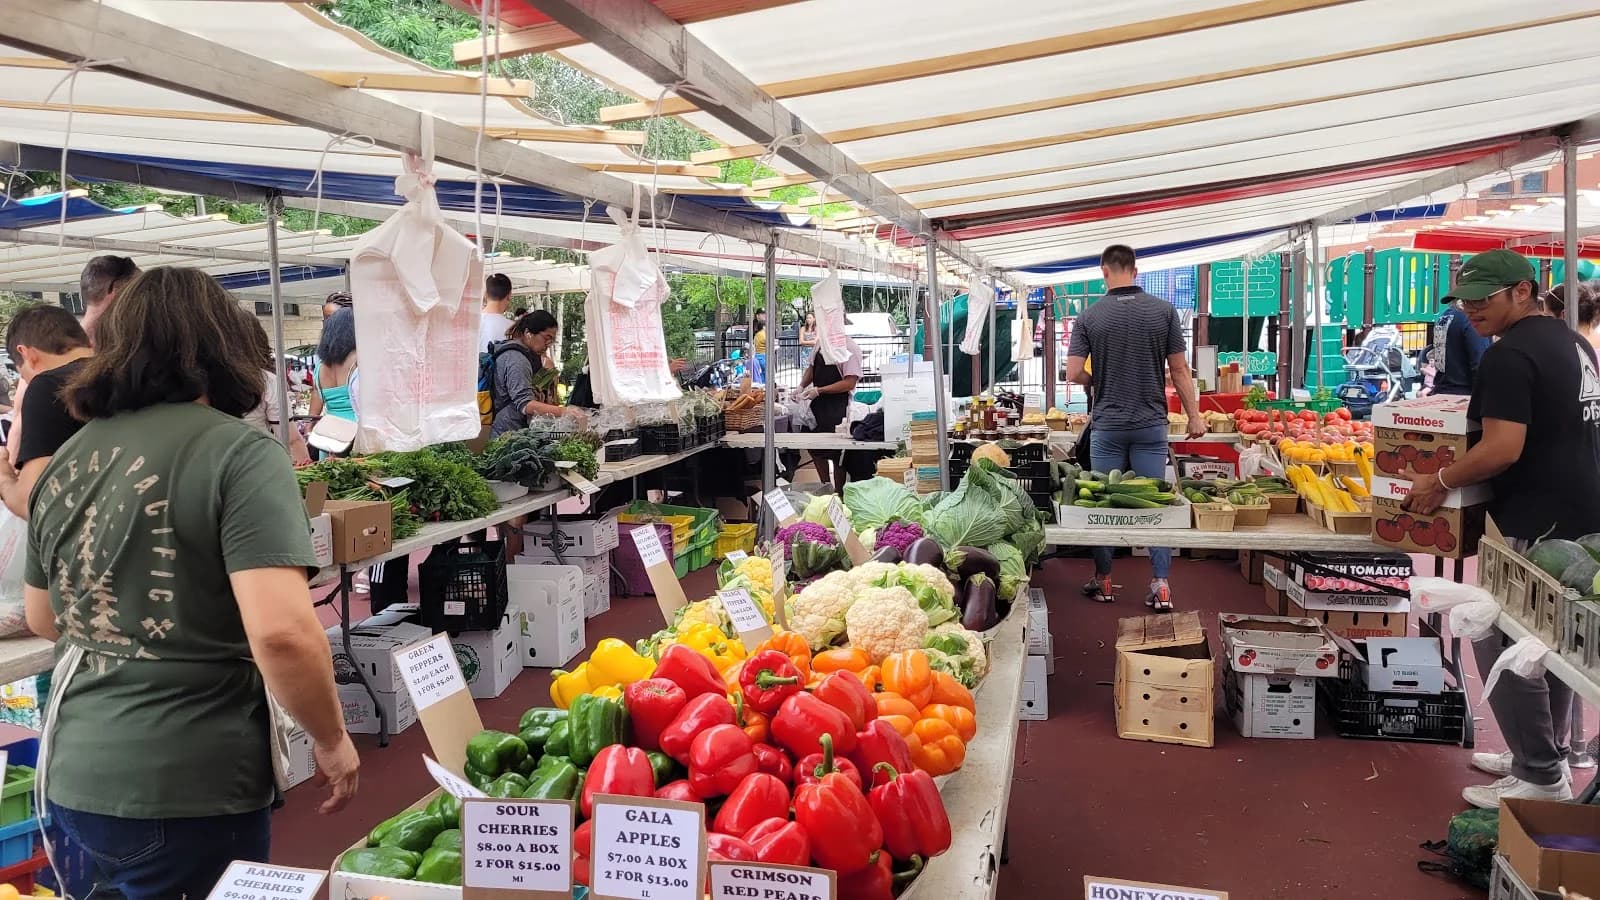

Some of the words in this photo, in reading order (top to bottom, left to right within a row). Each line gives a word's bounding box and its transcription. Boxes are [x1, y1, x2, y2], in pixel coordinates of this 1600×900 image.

[1392, 412, 1444, 428] Tomatoes
[1087, 513, 1134, 526] TOMATOES
[125, 456, 177, 602] PACIFIC
[1350, 565, 1410, 576] TOMATOES
[1351, 595, 1388, 606] TOMATOES
[408, 643, 435, 660] GREEN
[409, 653, 444, 673] PEPPERS
[429, 663, 450, 677] EACH
[421, 684, 436, 694] FOR
[436, 674, 454, 687] $5.00
[495, 805, 540, 817] SOUR
[625, 809, 673, 825] GALA
[478, 823, 559, 836] CHERRIES
[615, 830, 681, 849] APPLES
[477, 842, 512, 852] $8.00
[515, 843, 526, 852] A
[529, 843, 559, 854] BOX
[474, 860, 483, 868] 2
[486, 859, 514, 869] FOR
[518, 860, 561, 871] $15.00
[607, 851, 642, 864] $7.00
[644, 855, 655, 866] A
[658, 856, 688, 869] BOX
[246, 866, 306, 881] RAINIER
[512, 875, 523, 883] MI
[604, 870, 613, 879] 2
[615, 870, 644, 883] FOR
[647, 874, 689, 888] $13.00
[730, 868, 813, 886] CRIMSON
[233, 878, 305, 894] CHERRIES
[641, 889, 650, 898] IL
[722, 885, 762, 898] RED
